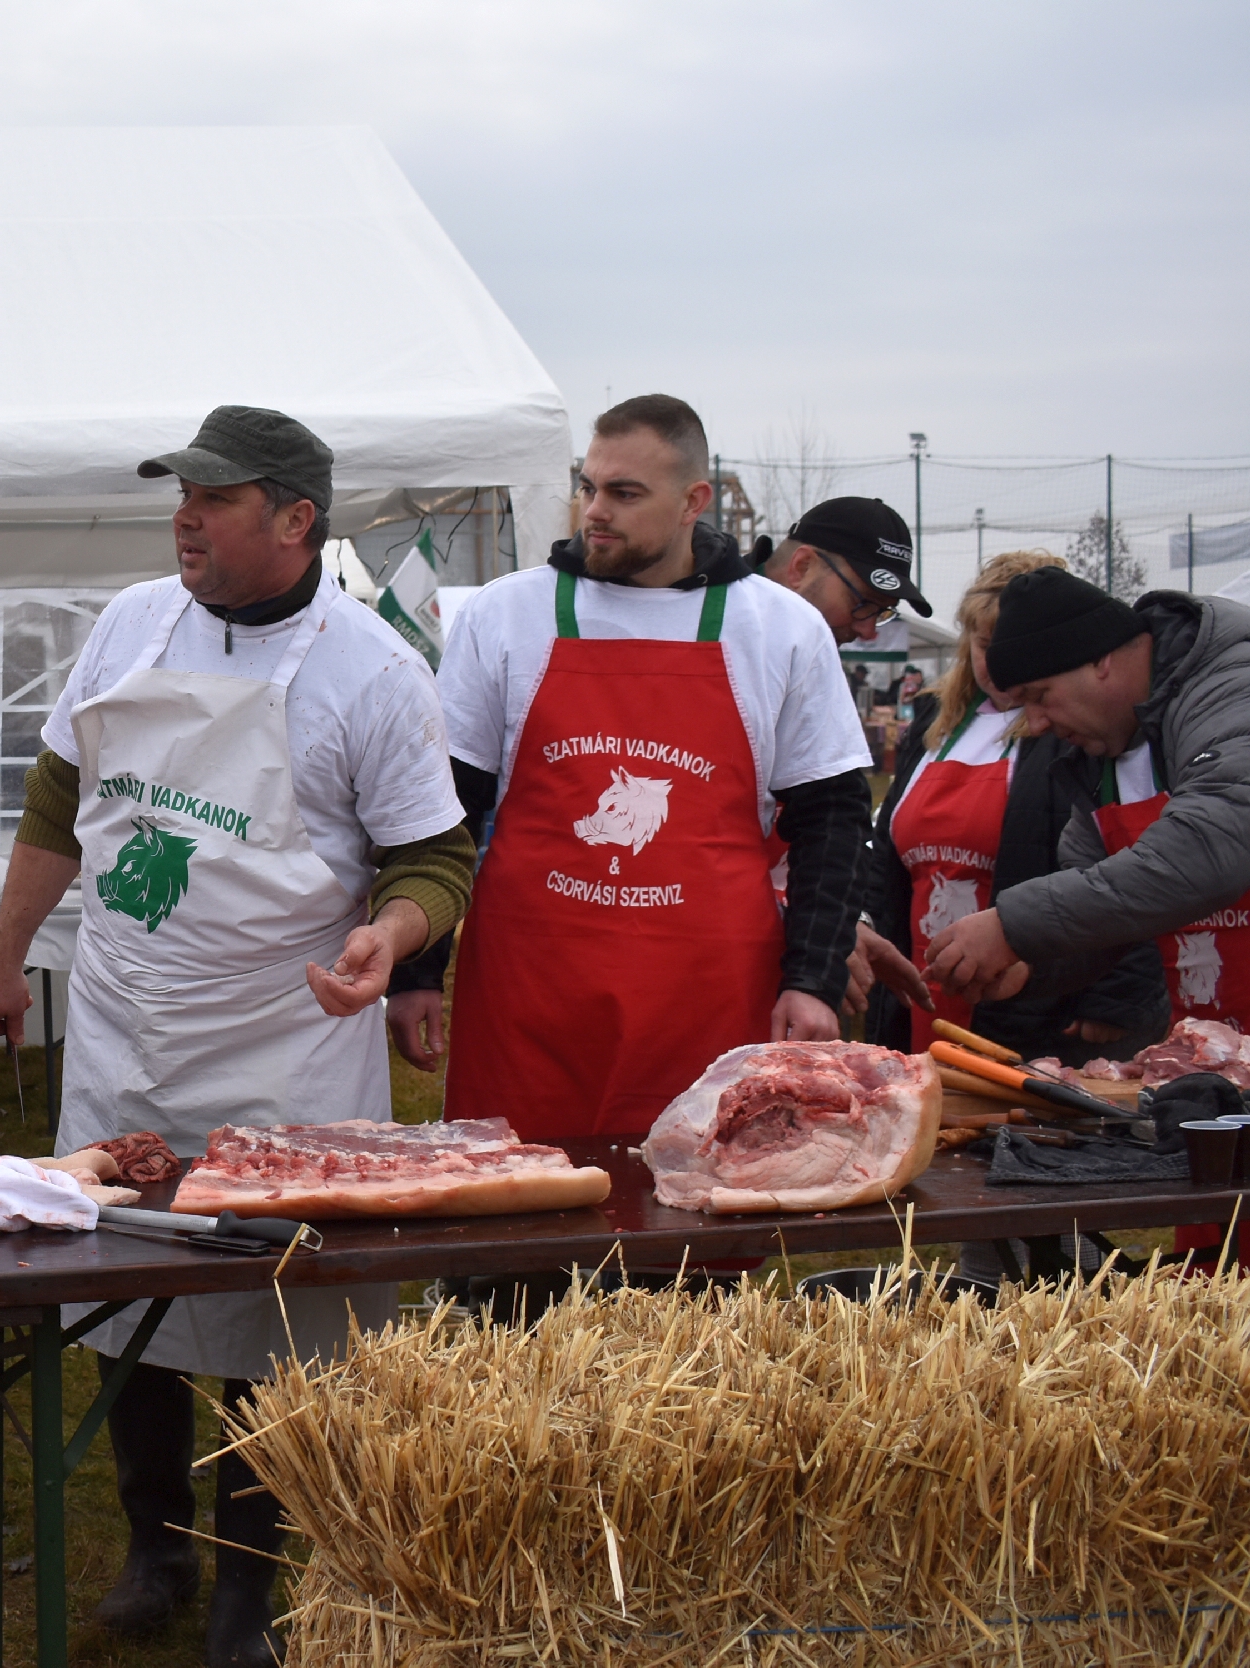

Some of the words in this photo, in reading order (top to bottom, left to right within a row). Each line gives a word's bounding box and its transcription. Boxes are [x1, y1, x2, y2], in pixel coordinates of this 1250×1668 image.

[543, 732, 621, 763] SZATMÁRI
[625, 738, 716, 782] VADKANOK
[97, 773, 146, 803] ATMÁRI
[151, 785, 252, 841] VADKANOK
[609, 856, 620, 875] &
[547, 870, 616, 906] CSORVÁSI
[619, 884, 684, 907] SZERVIZ
